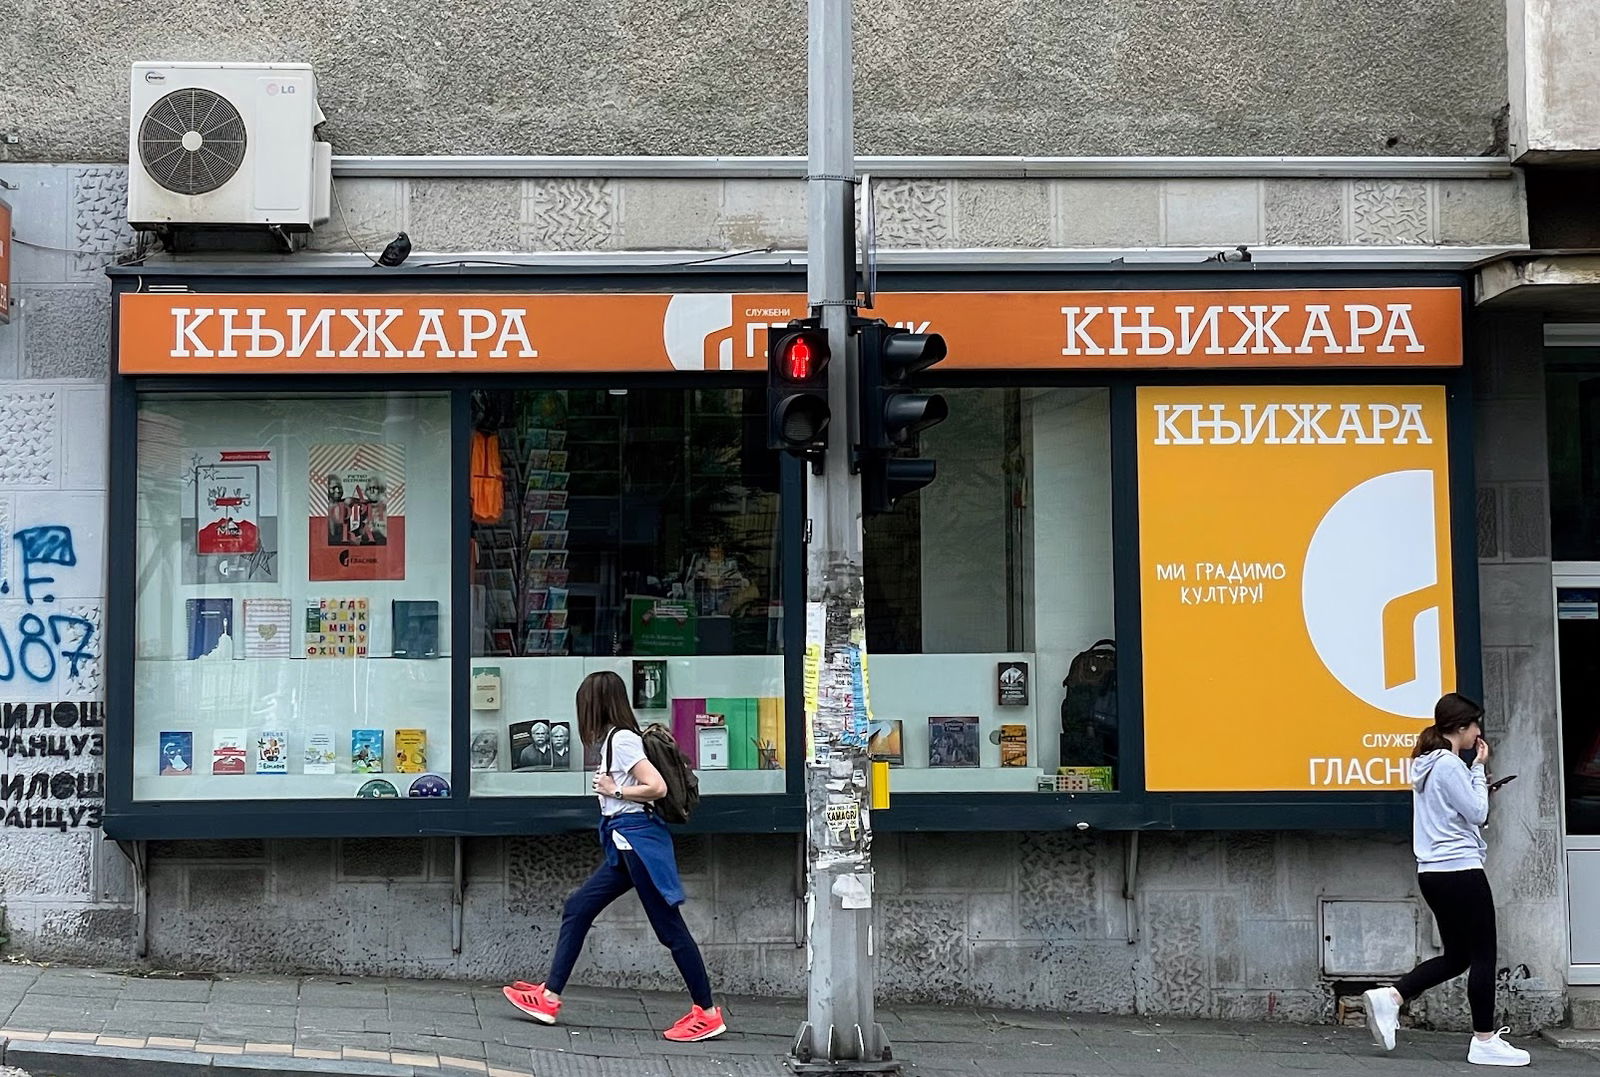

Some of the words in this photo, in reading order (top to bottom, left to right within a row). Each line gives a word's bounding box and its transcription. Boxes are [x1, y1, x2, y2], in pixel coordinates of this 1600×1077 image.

[281, 85, 295, 94] LG
[745, 308, 790, 317] СЛУЖБЕНИ
[170, 308, 538, 358] КЊИЖАРА
[1061, 304, 1425, 356] КЊИЖАРА
[1154, 404, 1432, 445] КЊИЖАРА
[1156, 564, 1186, 581] МИ
[1195, 561, 1286, 584] ГРАДИМО
[1181, 583, 1263, 605] КУЛТУРУ!
[0, 701, 104, 728] ИЛОШ
[1362, 733, 1420, 748] СЛУЖБ
[1308, 757, 1412, 786] ГЛАСН
